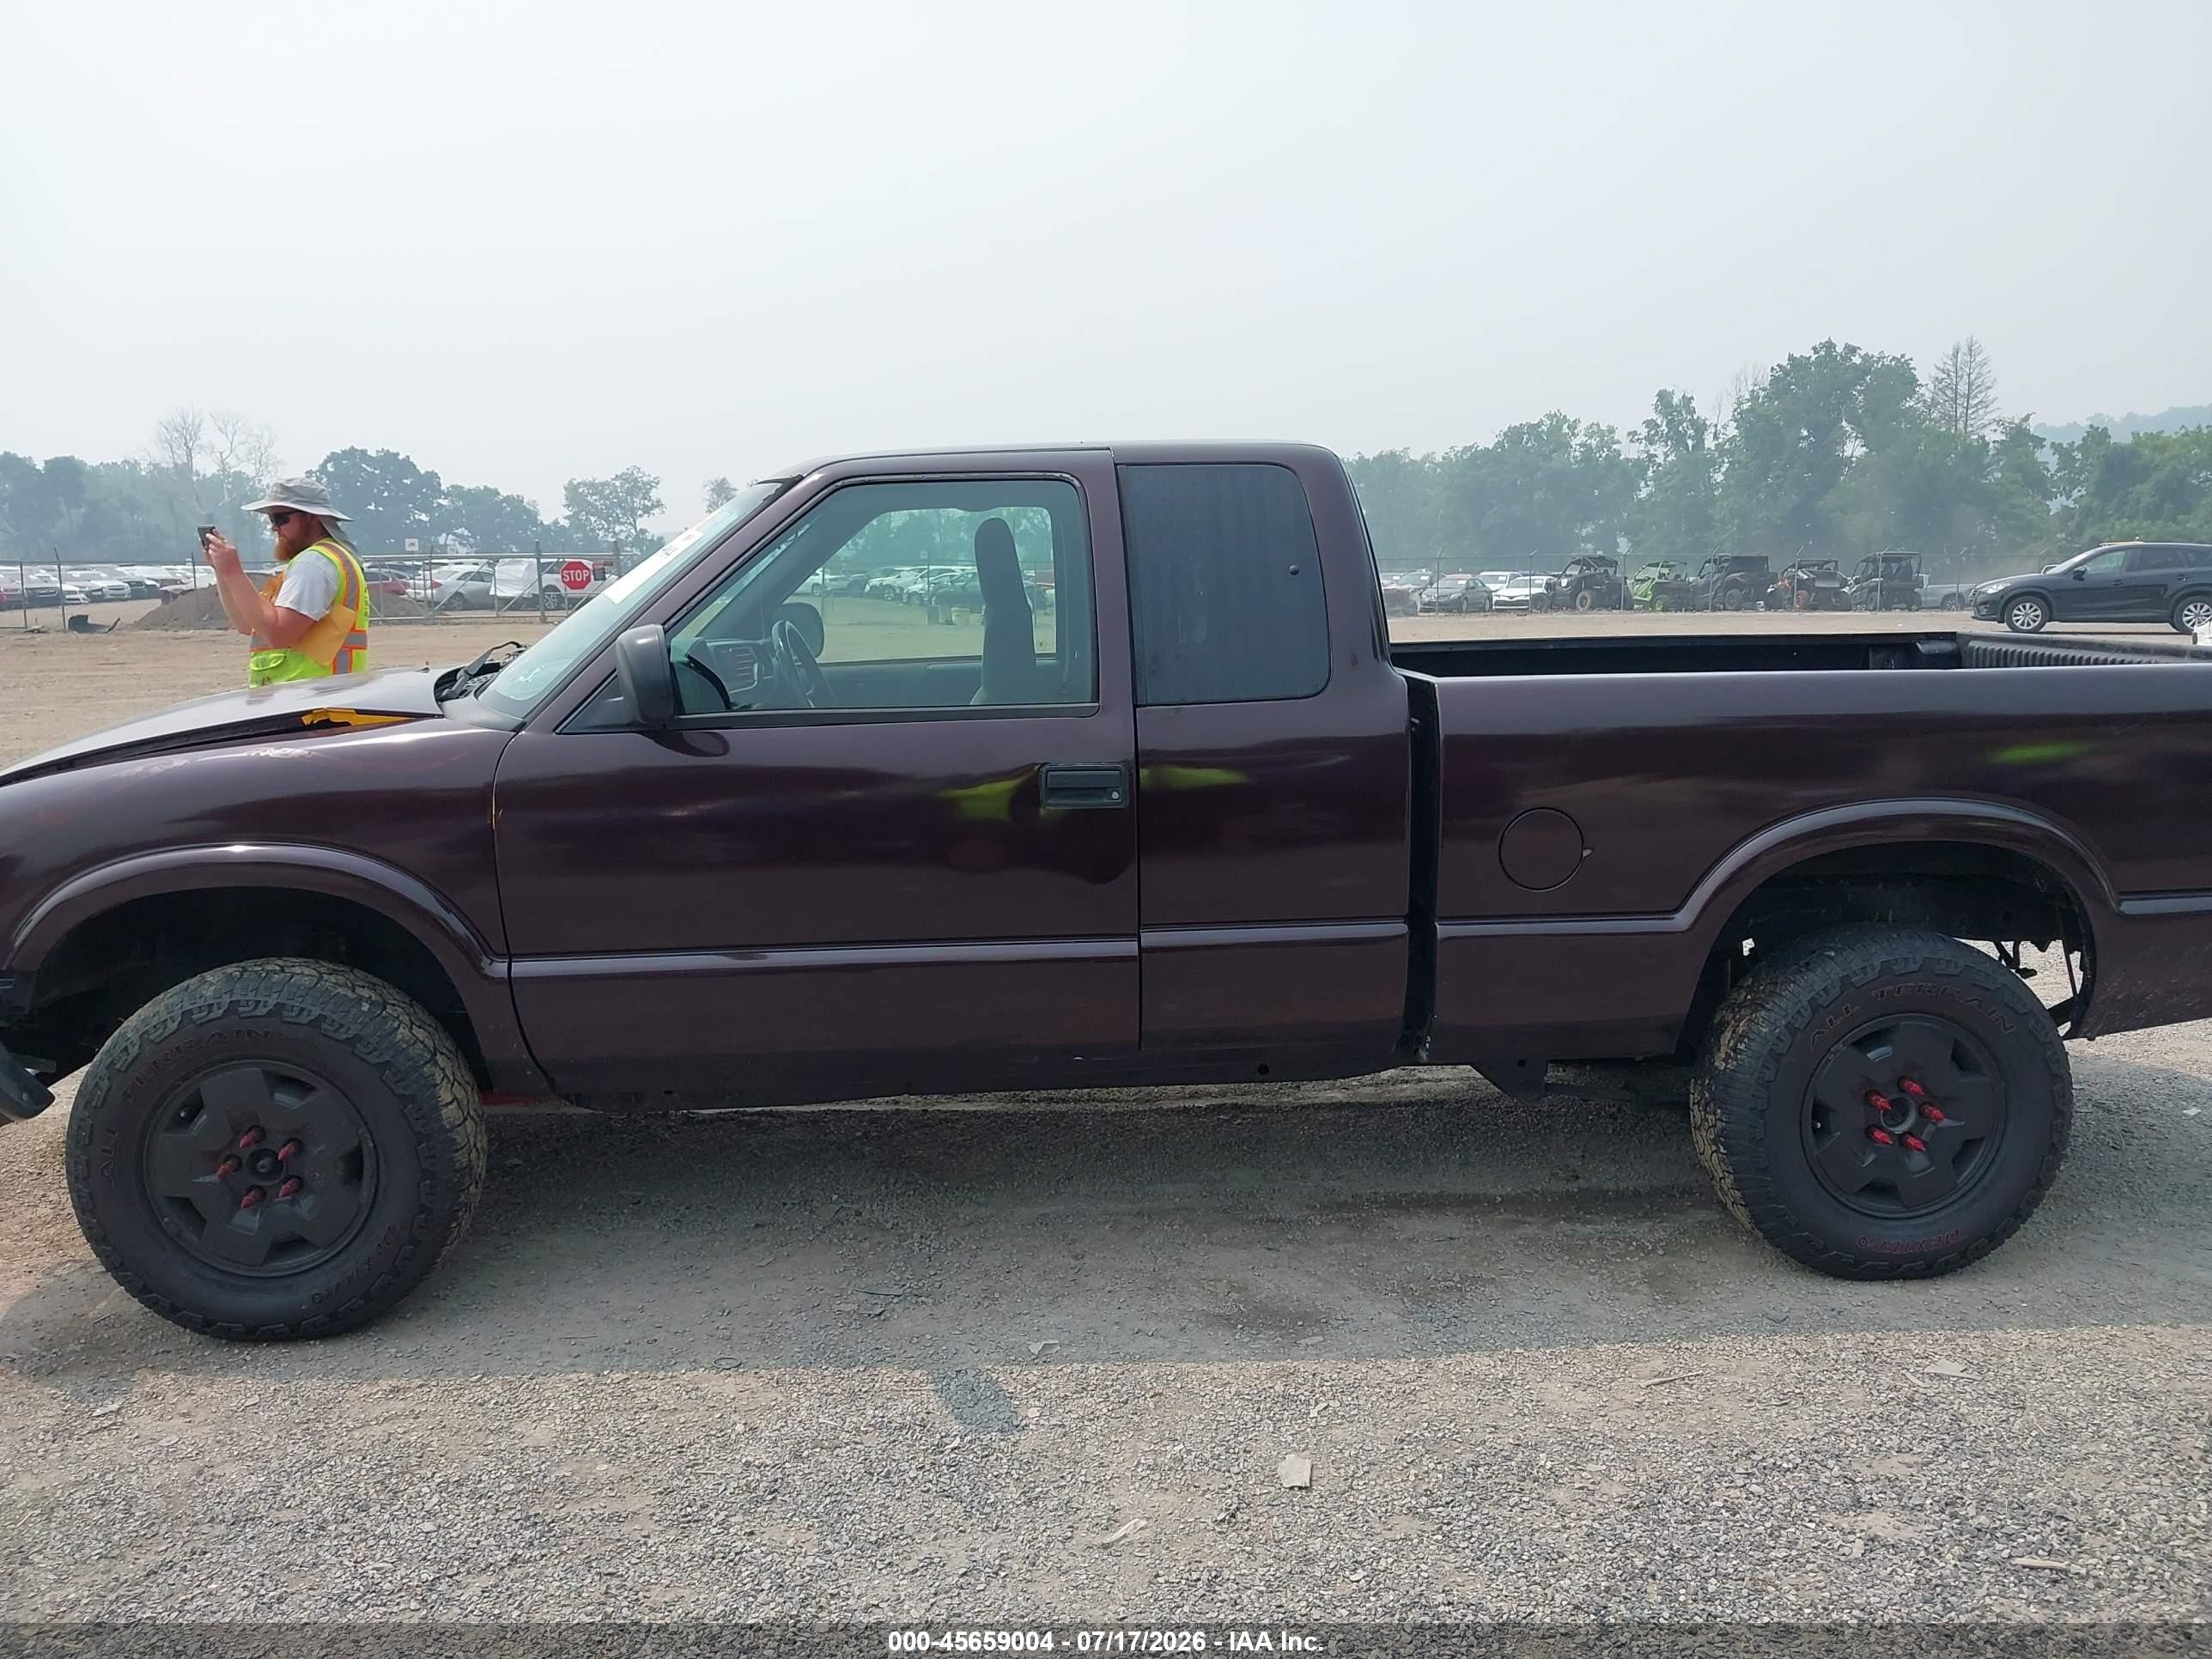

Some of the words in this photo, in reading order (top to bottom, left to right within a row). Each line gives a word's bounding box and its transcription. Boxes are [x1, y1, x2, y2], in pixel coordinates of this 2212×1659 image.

[562, 569, 590, 582] STOP
[1808, 1002, 1860, 1051] ALL
[1870, 982, 2017, 1034] TERRAIN
[99, 1127, 119, 1188] ALL
